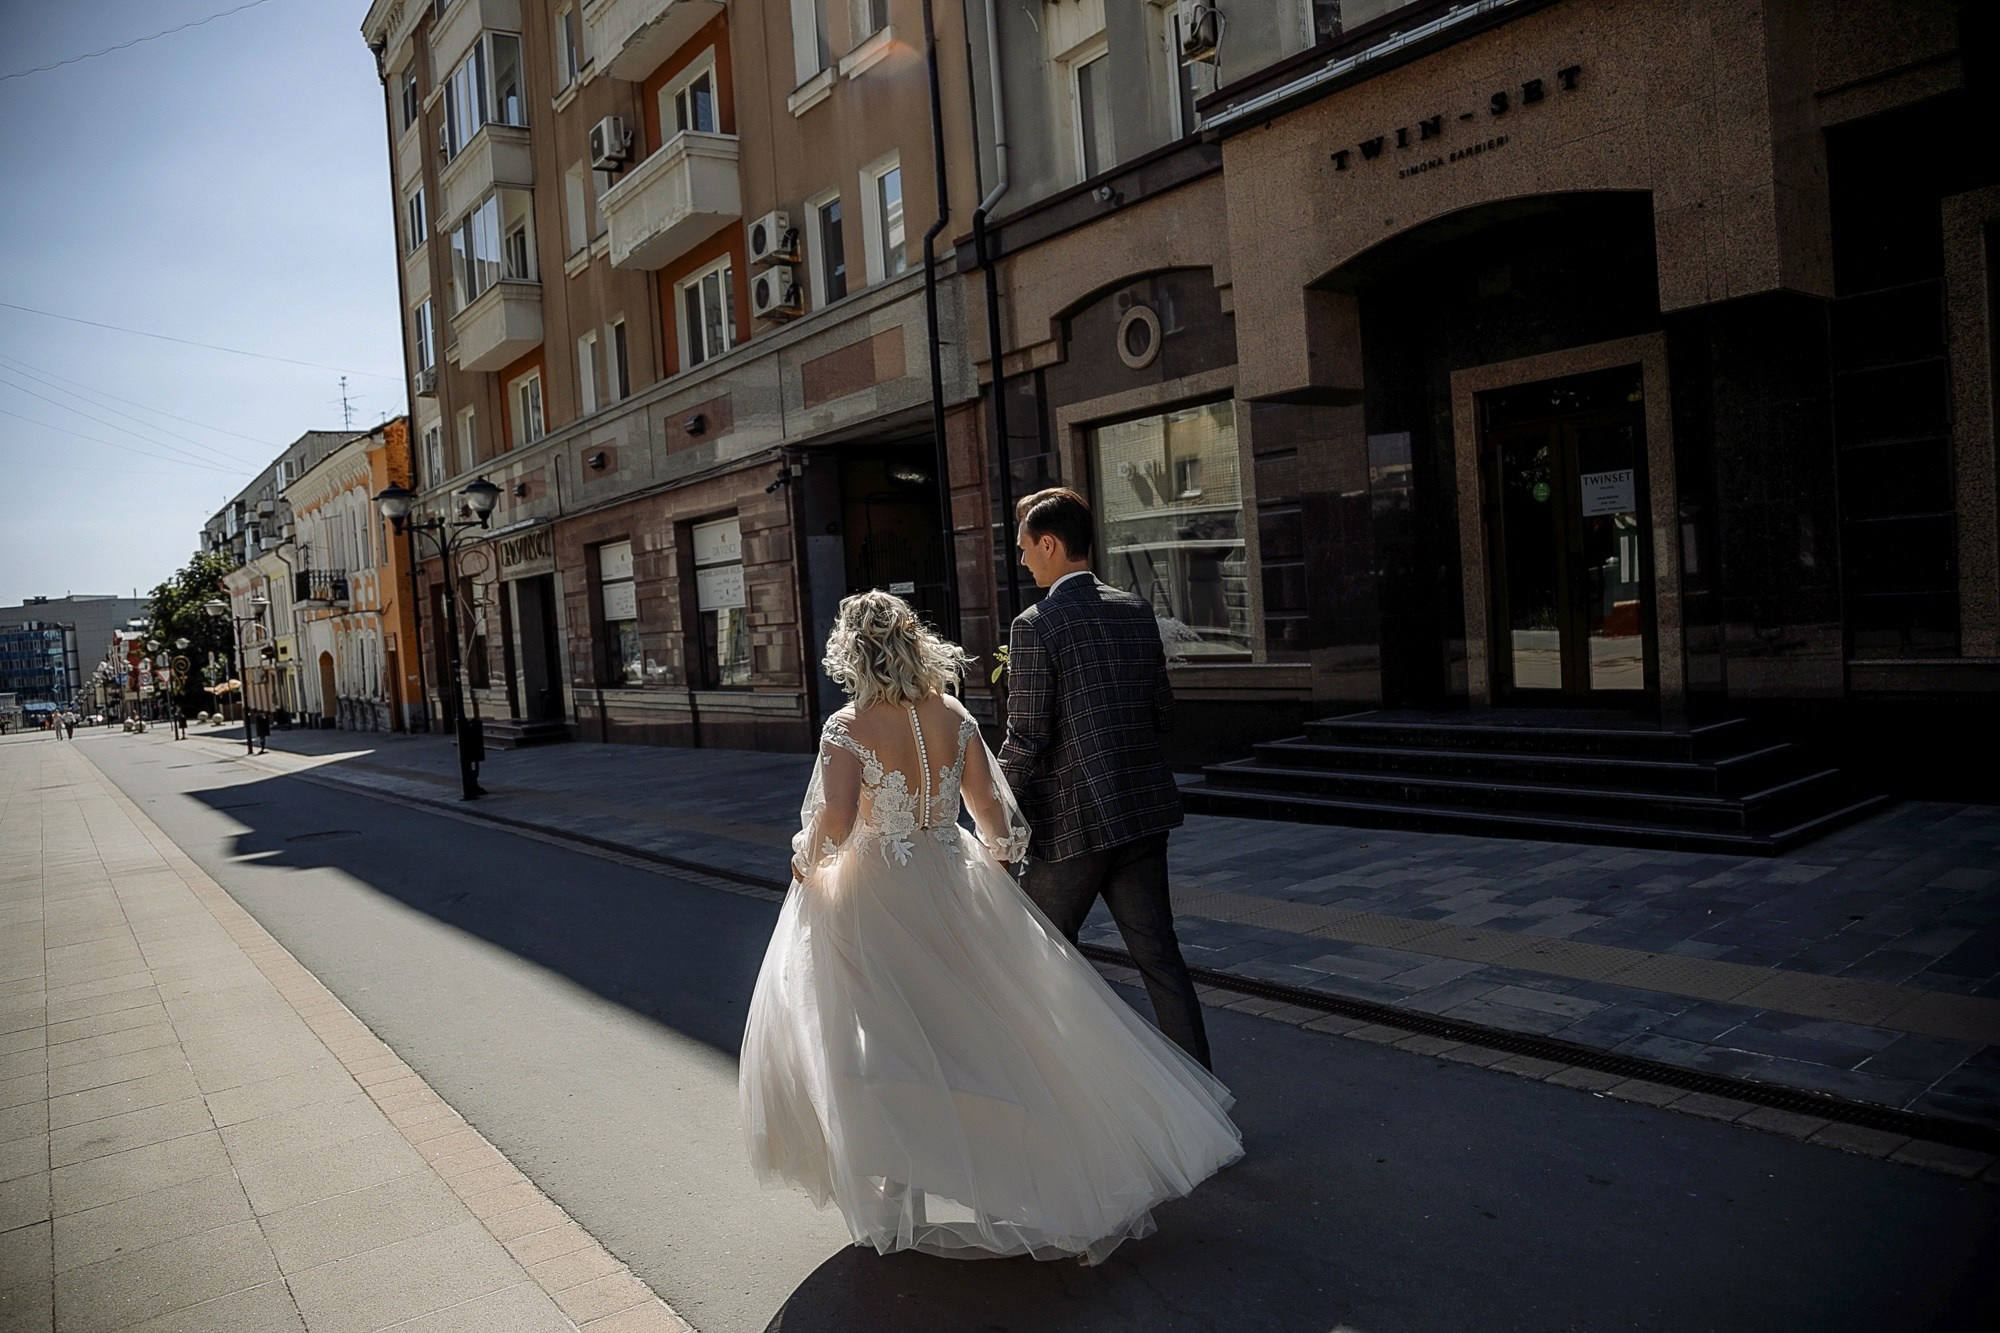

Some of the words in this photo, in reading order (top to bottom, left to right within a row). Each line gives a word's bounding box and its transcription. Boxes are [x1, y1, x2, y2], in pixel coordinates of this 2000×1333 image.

[1330, 64, 1582, 171] TWIN-SET
[1398, 157, 1444, 180] SIMONA
[1449, 134, 1509, 164] BARBIERI
[1583, 471, 1632, 486] TWINSET
